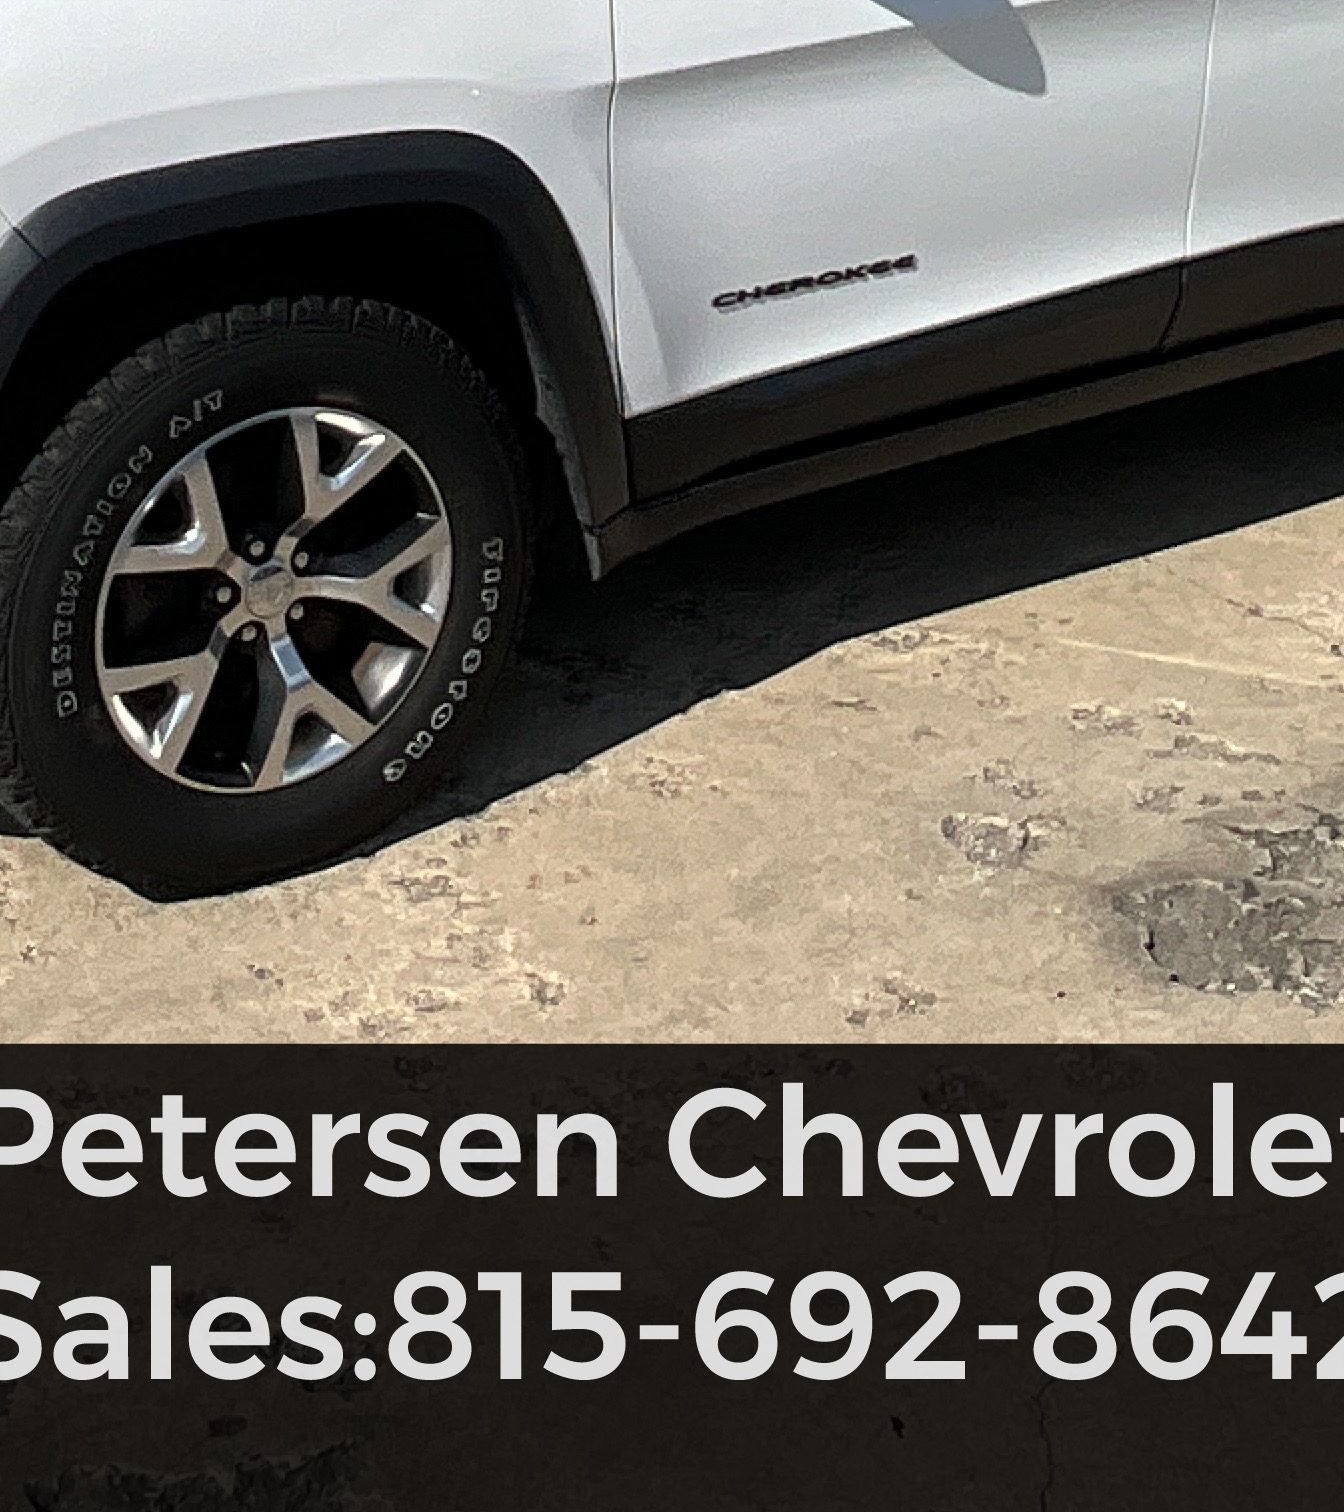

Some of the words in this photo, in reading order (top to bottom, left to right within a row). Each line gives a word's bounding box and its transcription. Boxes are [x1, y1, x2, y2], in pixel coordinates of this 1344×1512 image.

[711, 254, 917, 310] CHEROKEE
[51, 444, 153, 718] DESTINATION
[169, 390, 223, 439] A/T
